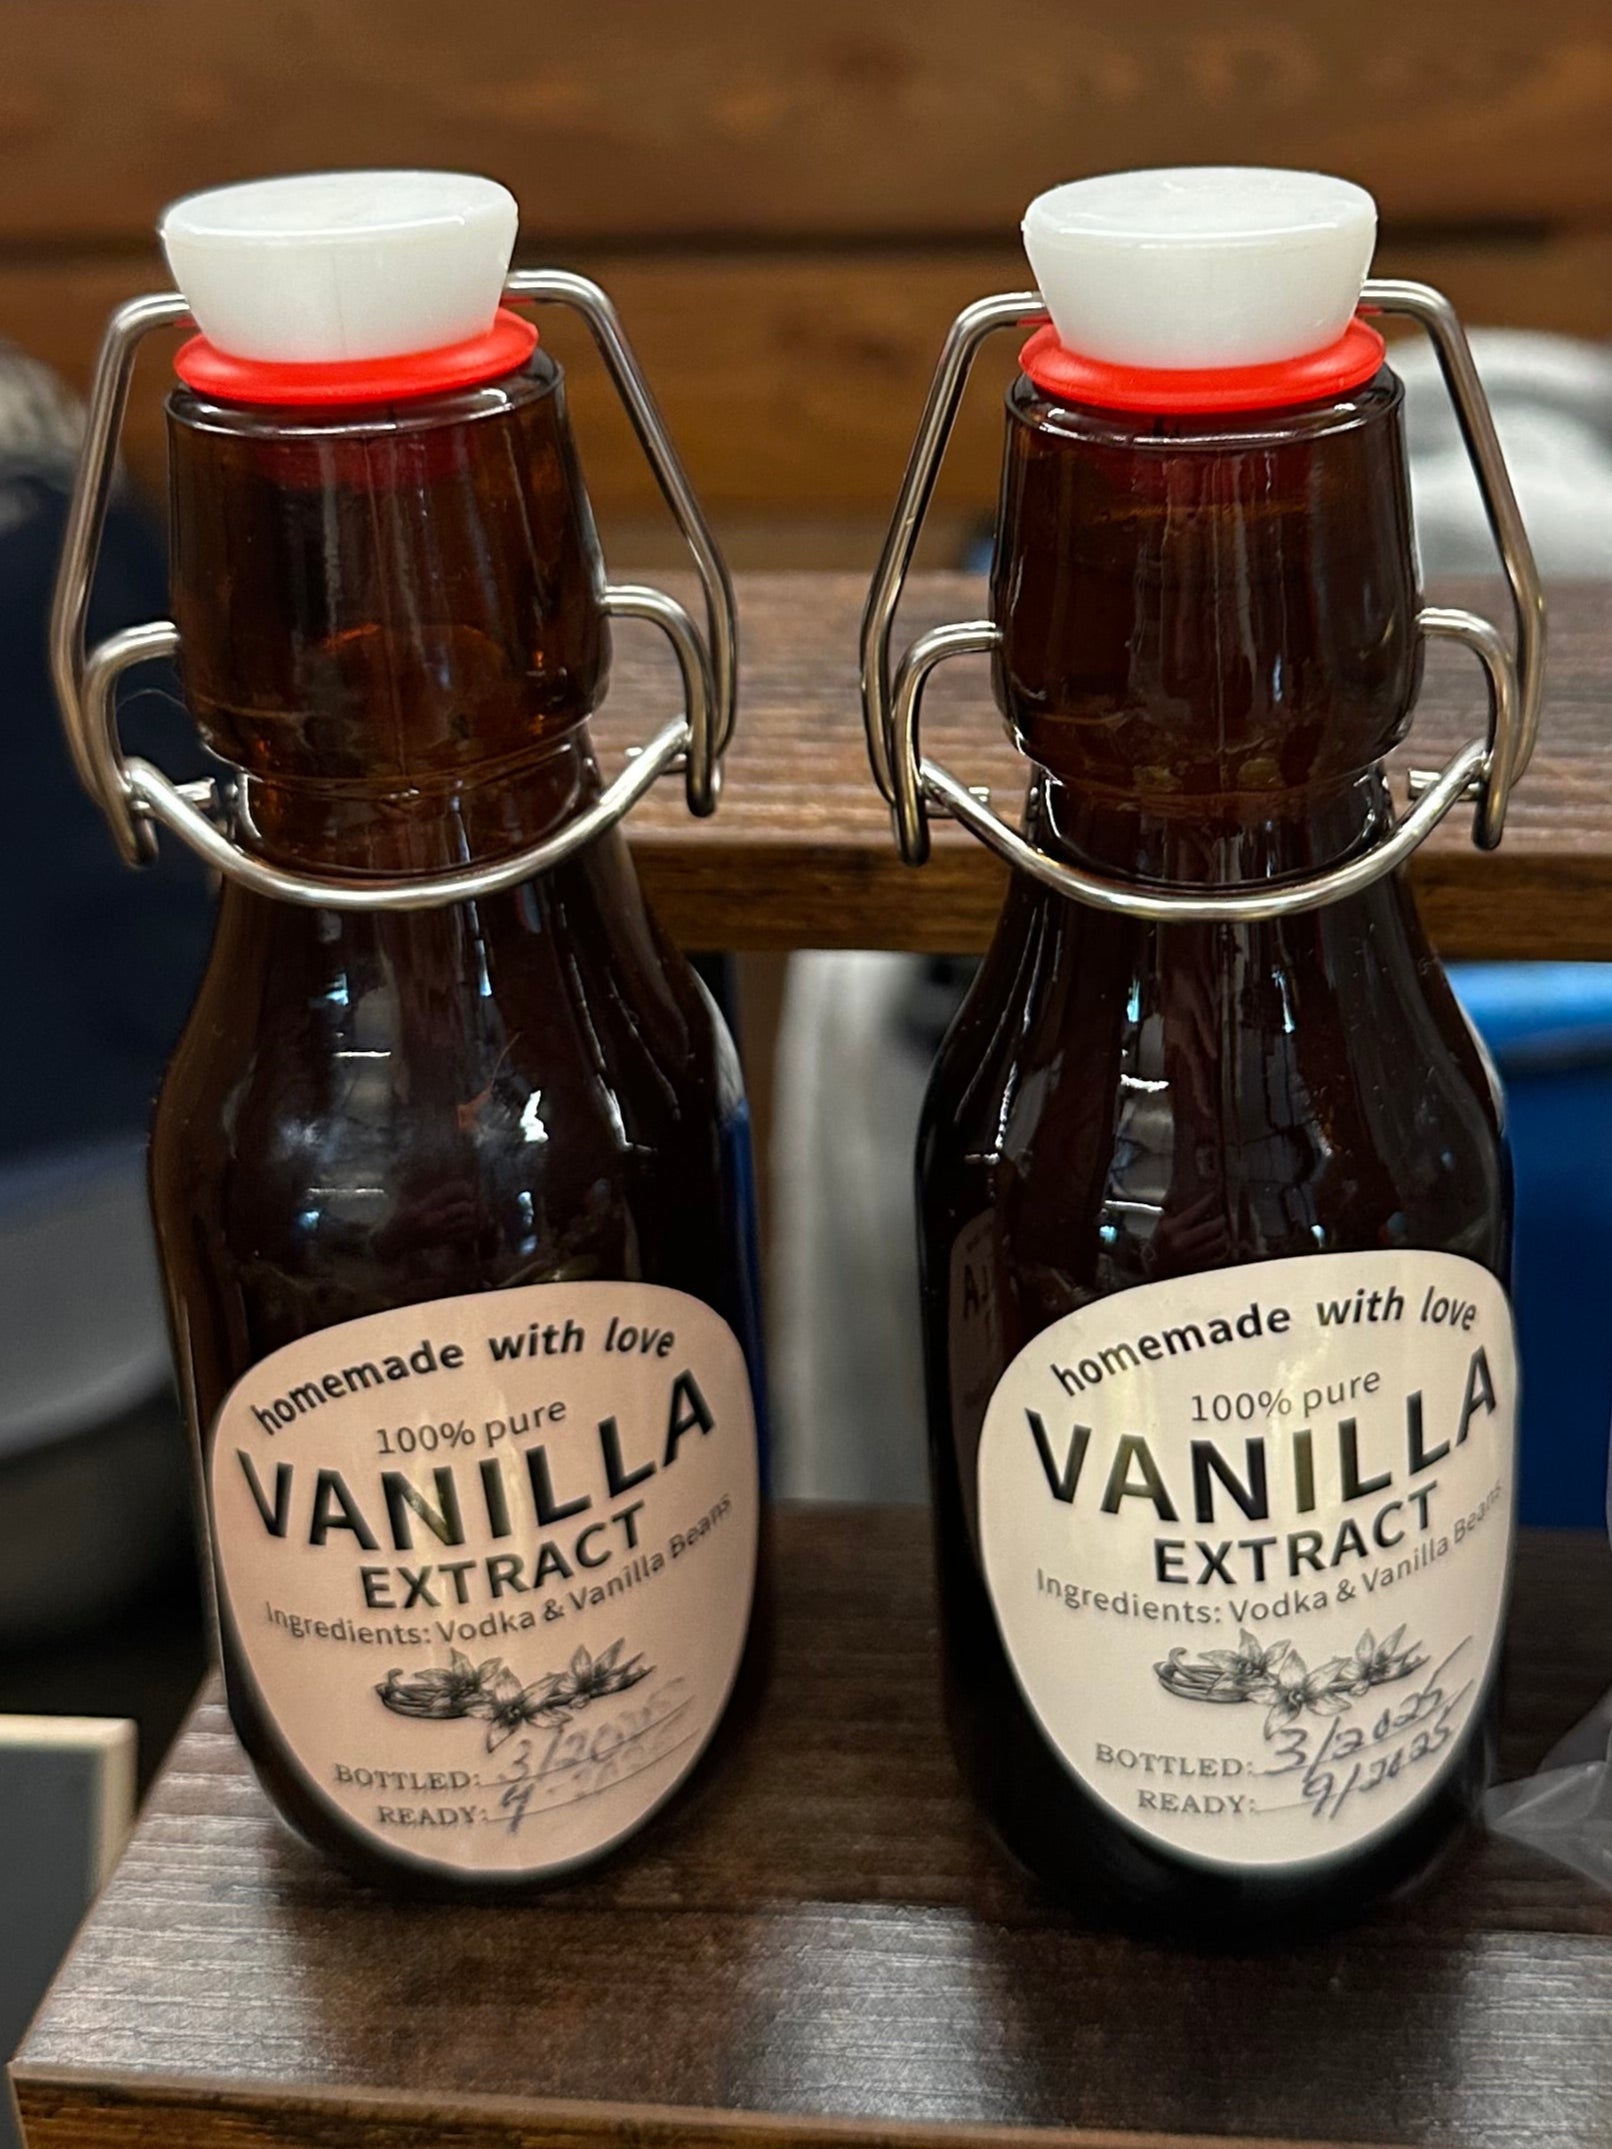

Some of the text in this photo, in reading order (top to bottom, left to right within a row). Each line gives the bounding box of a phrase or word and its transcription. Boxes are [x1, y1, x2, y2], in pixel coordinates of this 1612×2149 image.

[251, 1316, 675, 1436] homemade with love
[1050, 1302, 1291, 1397] homemade
[1317, 1287, 1405, 1328] with
[1419, 1285, 1477, 1332] love
[376, 1399, 567, 1455] 100% pure
[1024, 1344, 1498, 1524] VANILLA
[1190, 1369, 1381, 1422] 100% pure
[235, 1368, 715, 1552] VANILLA
[265, 1493, 731, 1645] Ingredients: Vodka & Vanilla Beans
[358, 1500, 646, 1610] EXTRACT
[1036, 1568, 1221, 1624] Ingredients:
[1228, 1591, 1329, 1624] Vodka
[1336, 1578, 1357, 1603] &
[1361, 1536, 1450, 1593] Vanilla
[1154, 1479, 1439, 1586] EXTRACT
[334, 1763, 481, 1790] BOTTLED:
[1095, 1742, 1254, 1779] BOTTLED:
[1136, 1788, 1257, 1816] READY:
[377, 1805, 489, 1828] READY:
